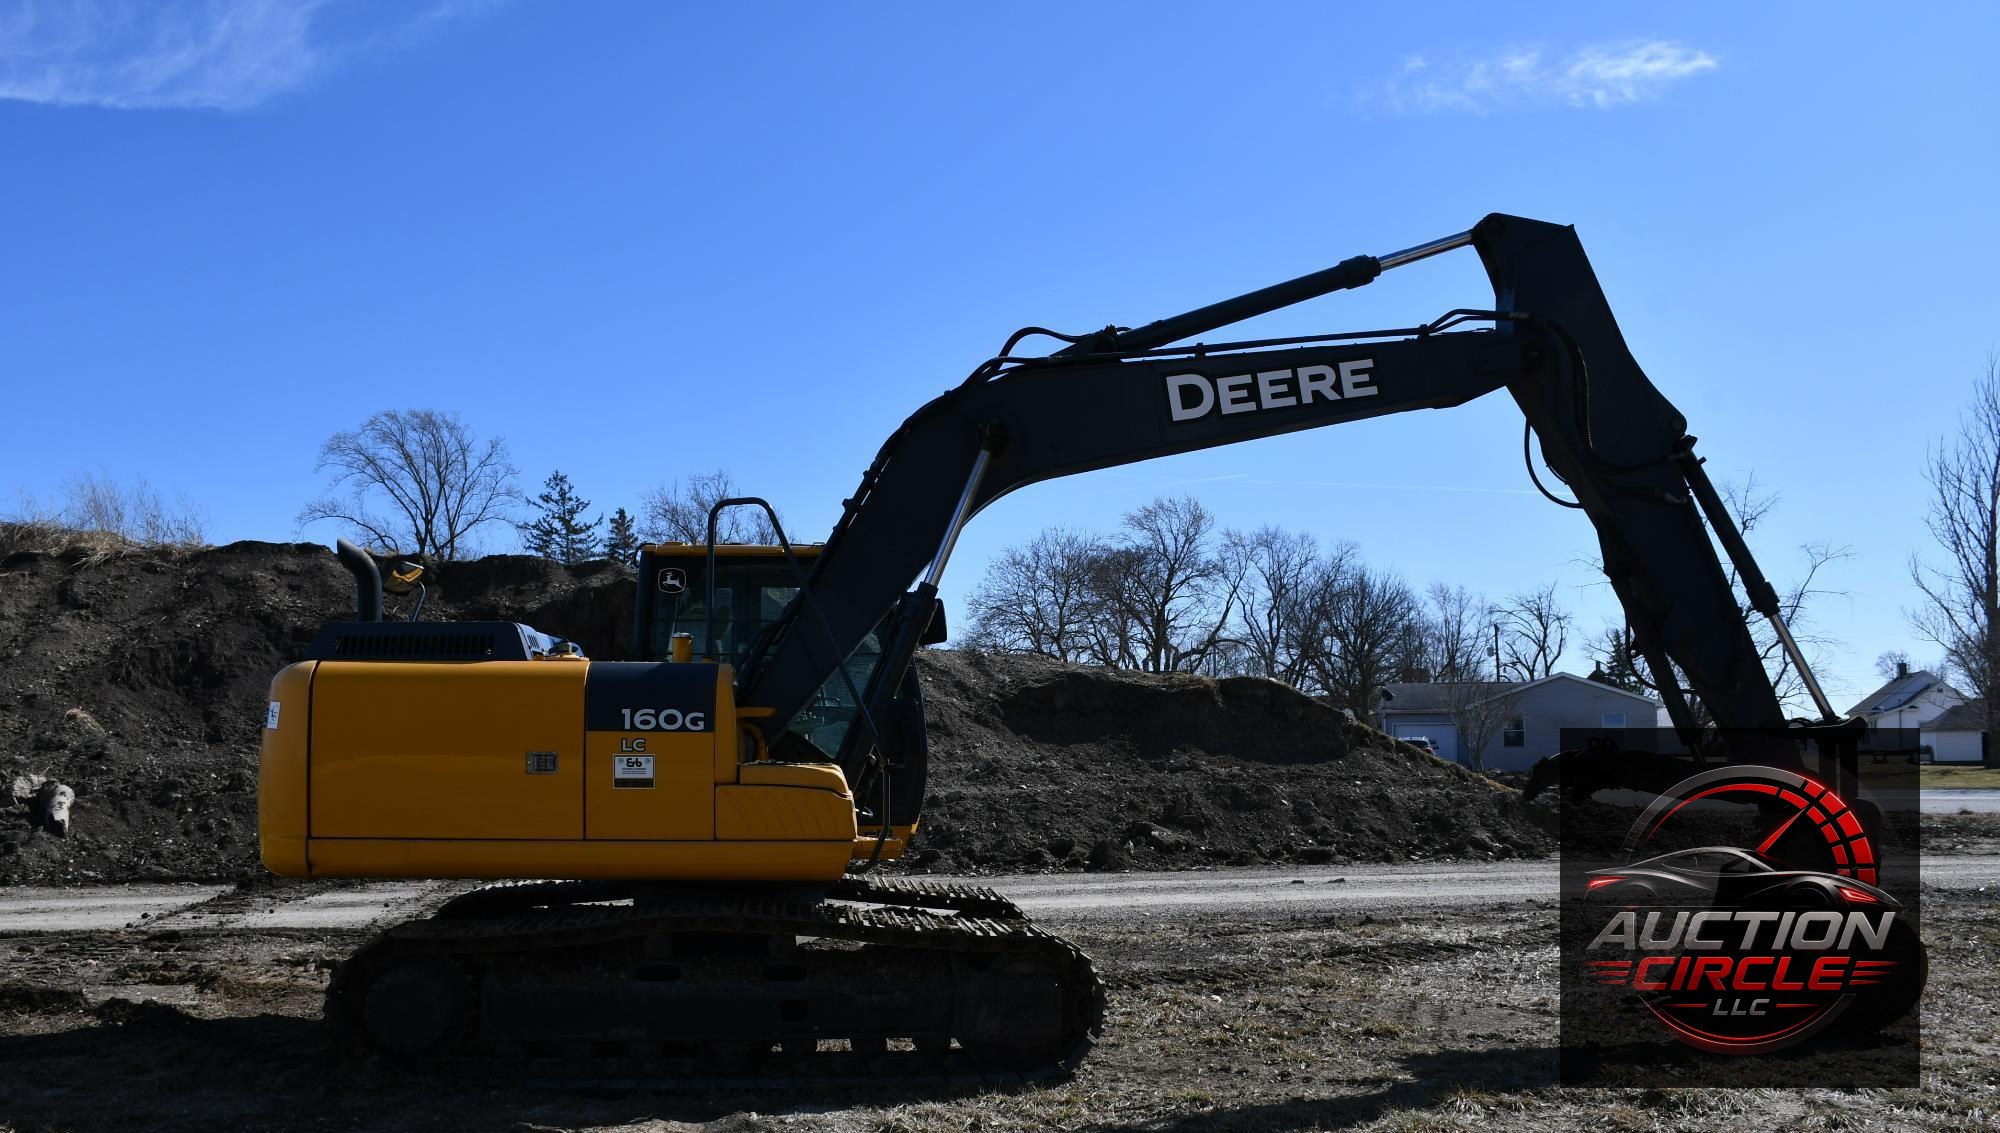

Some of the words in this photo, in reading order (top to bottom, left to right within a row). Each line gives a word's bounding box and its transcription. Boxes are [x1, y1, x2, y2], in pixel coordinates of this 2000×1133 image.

[1166, 358, 1378, 422] DEERE
[621, 708, 705, 731] 160G
[622, 739, 645, 752] LC
